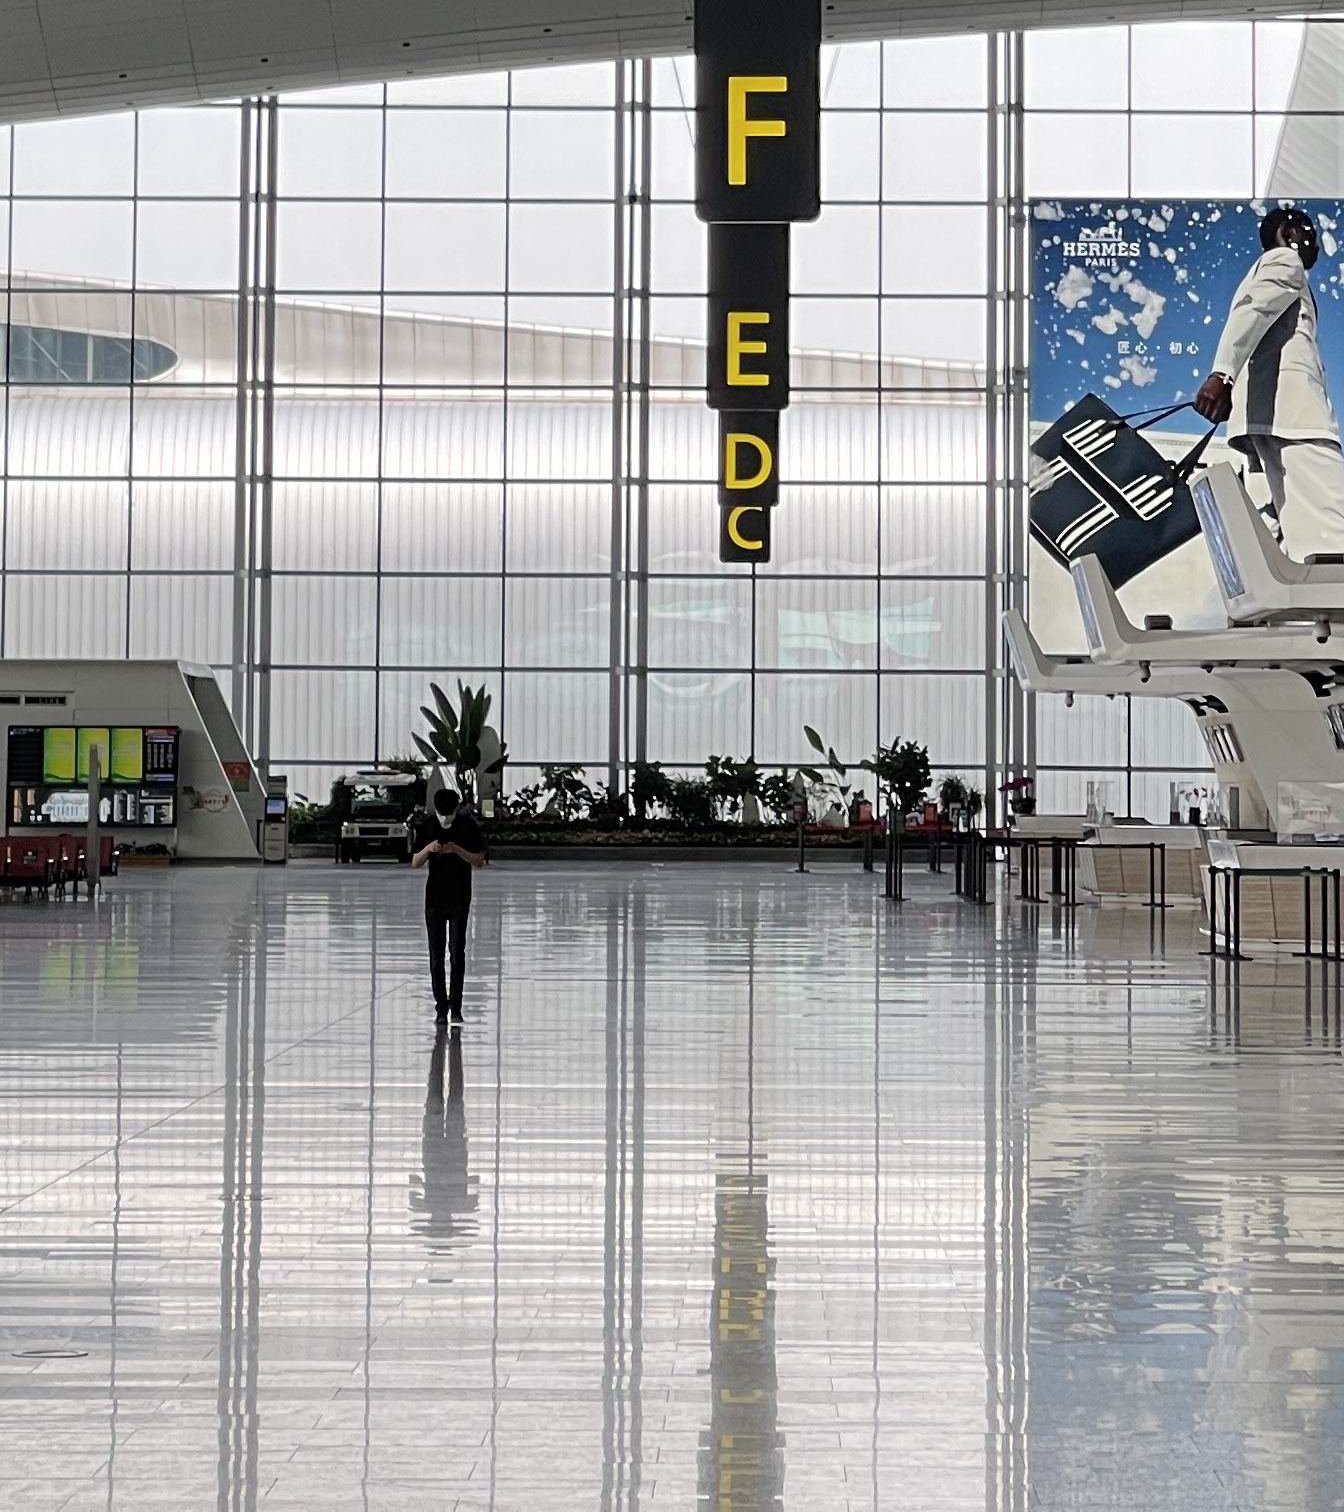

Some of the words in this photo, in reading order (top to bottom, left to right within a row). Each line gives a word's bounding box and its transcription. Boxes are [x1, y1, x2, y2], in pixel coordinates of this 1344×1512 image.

[728, 76, 788, 186] F
[1085, 258, 1117, 267] PARIS
[726, 311, 770, 386] E
[725, 433, 773, 490] D
[727, 506, 763, 550] C
